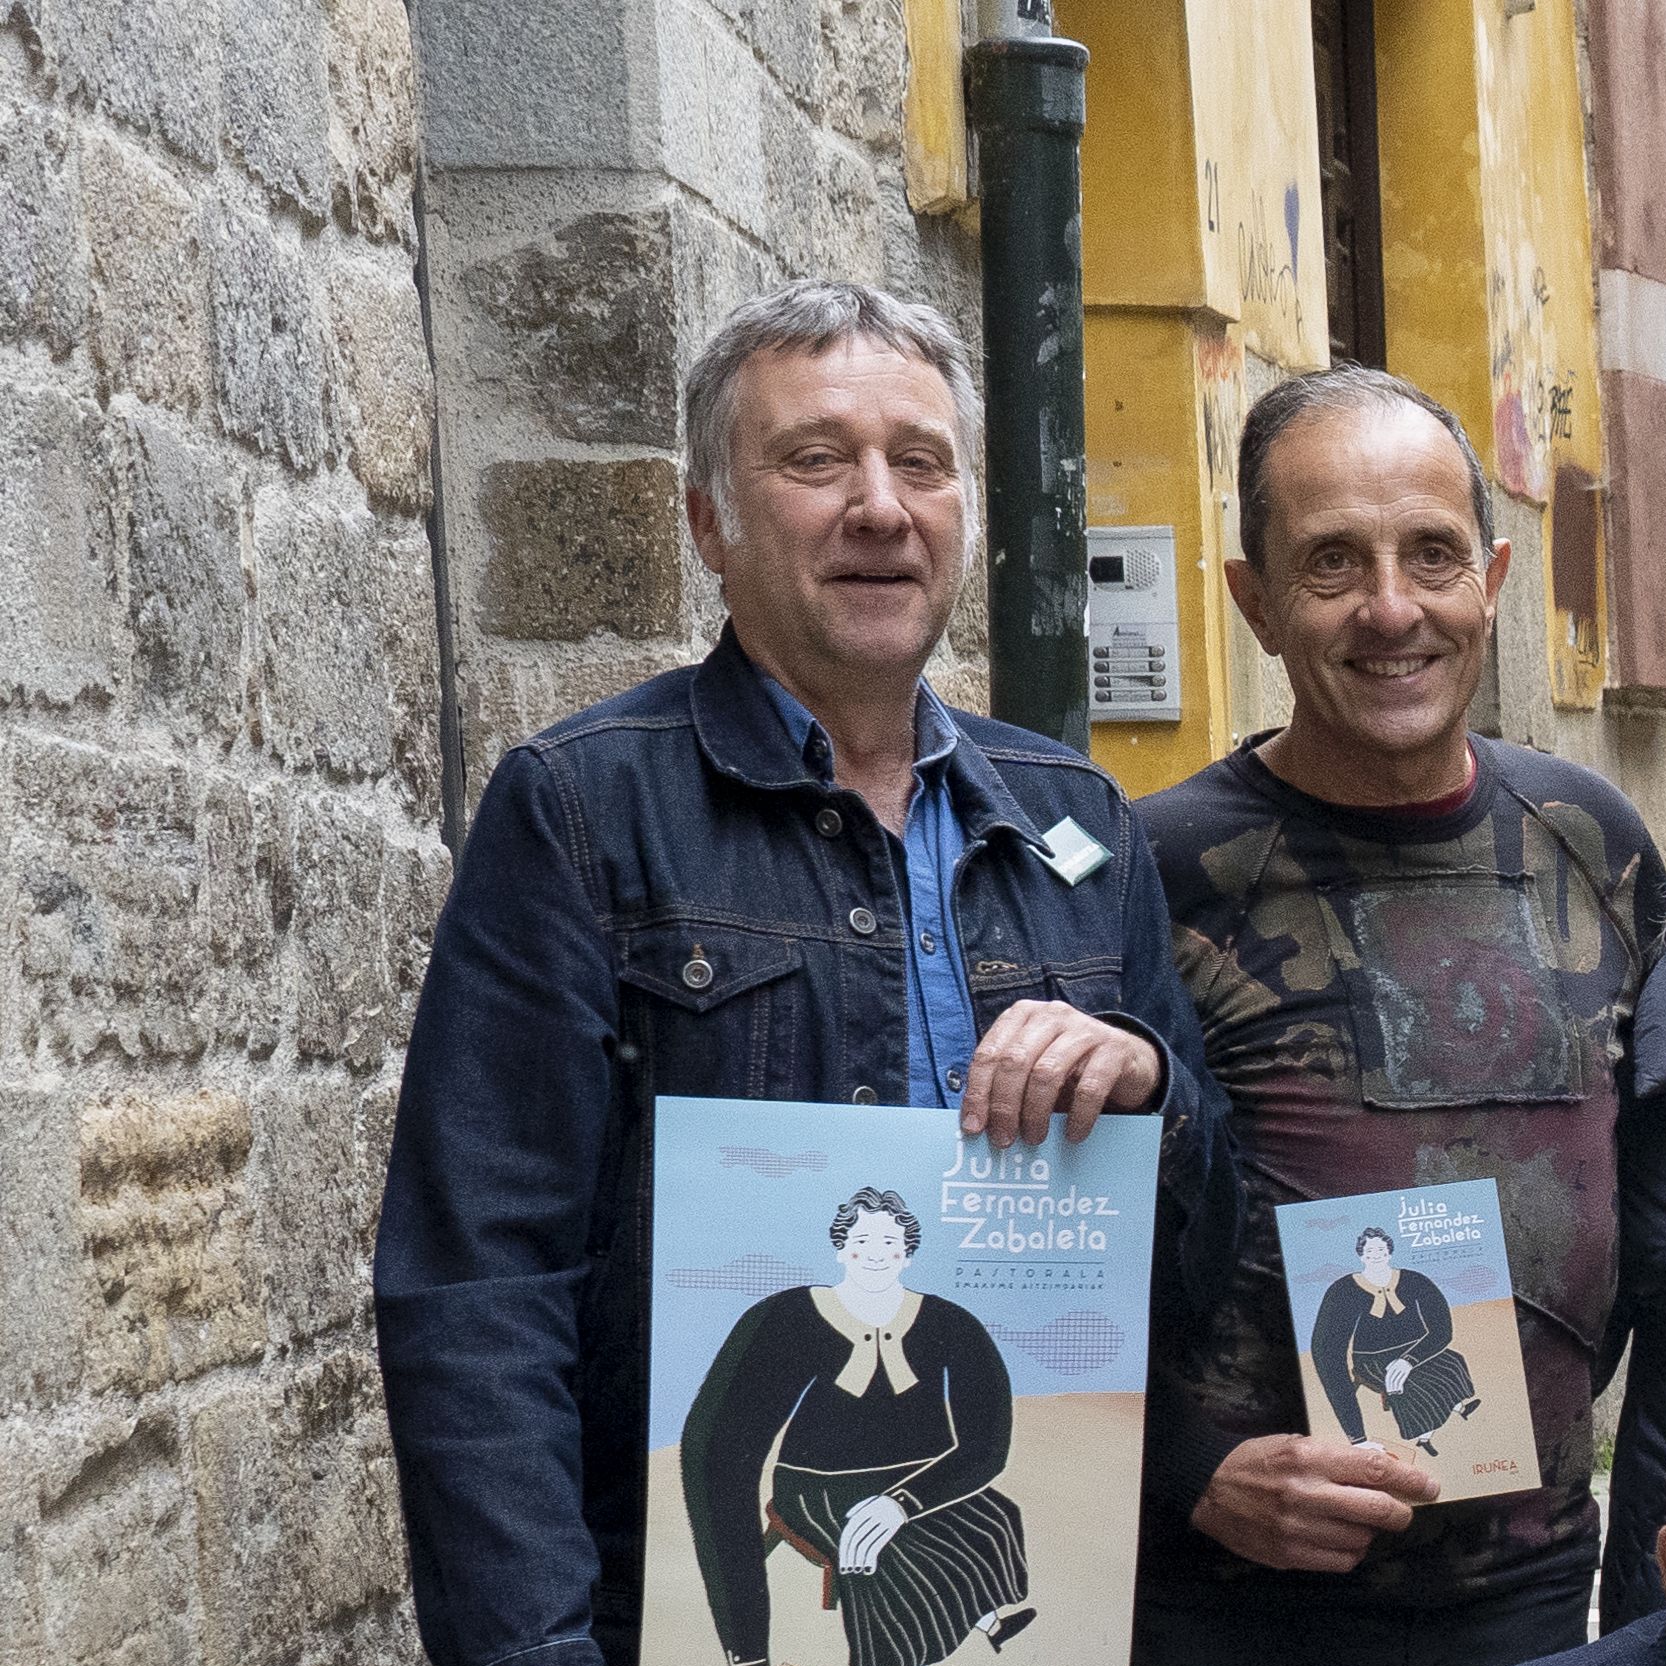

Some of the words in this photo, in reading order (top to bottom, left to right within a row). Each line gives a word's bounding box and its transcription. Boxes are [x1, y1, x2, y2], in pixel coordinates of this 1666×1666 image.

[941, 1181, 1120, 1220] Fernandez
[1398, 1196, 1447, 1218] Julia
[1398, 1211, 1485, 1233] Fernandez
[941, 1217, 1107, 1253] Zabaleta
[1401, 1226, 1481, 1247] Zabaleta
